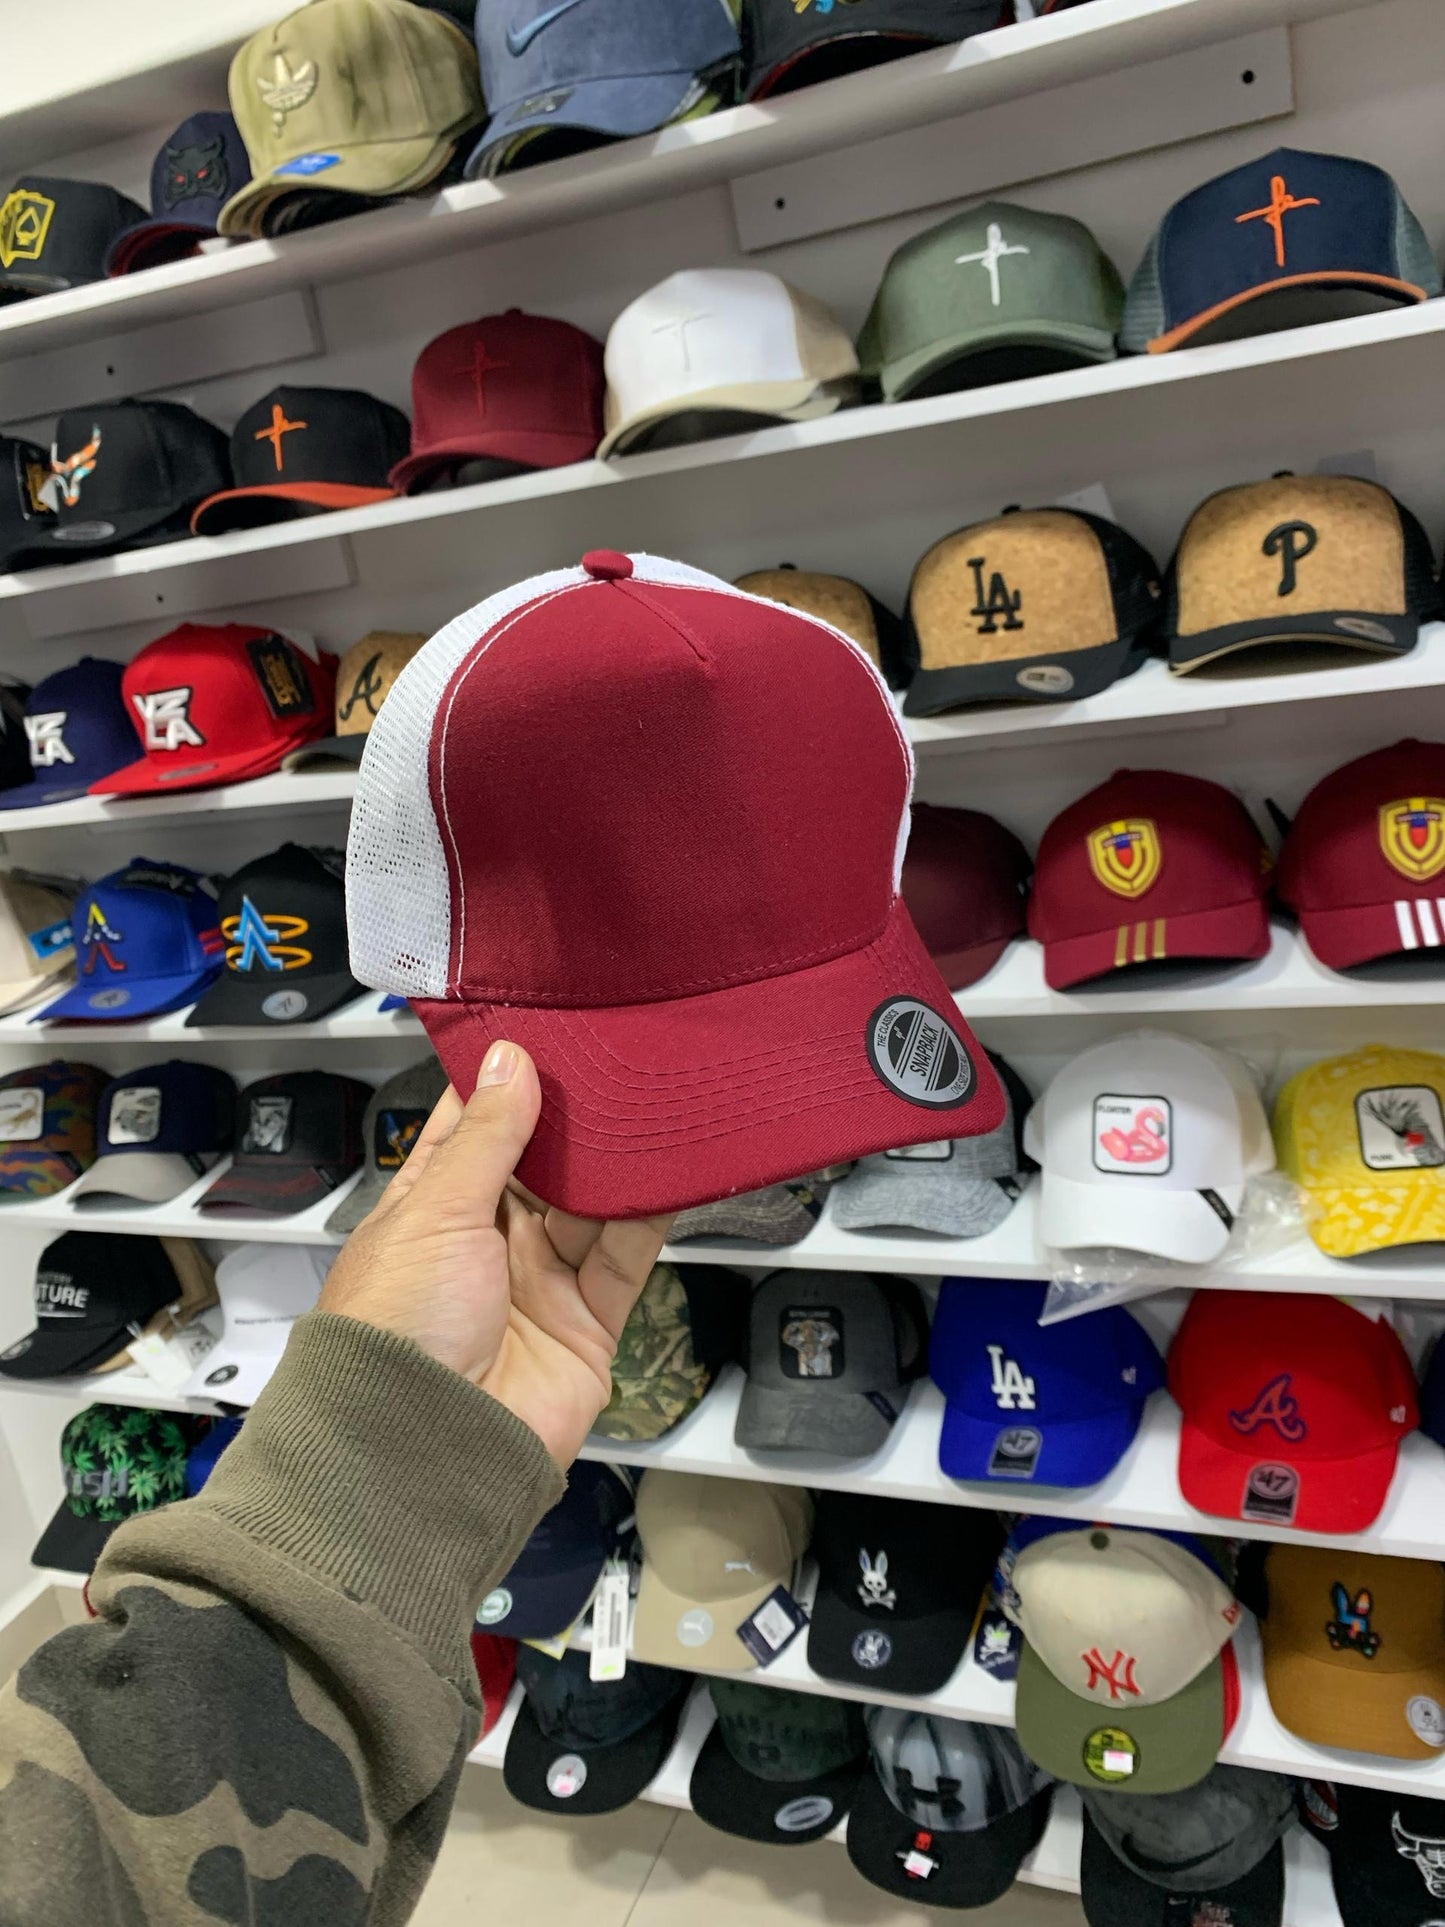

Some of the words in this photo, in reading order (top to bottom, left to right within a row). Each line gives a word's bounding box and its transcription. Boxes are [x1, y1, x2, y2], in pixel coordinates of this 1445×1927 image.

[1262, 520, 1318, 597] P
[967, 556, 1024, 634] LA
[339, 651, 387, 721] A
[877, 1033, 887, 1047] THE
[879, 1009, 900, 1034] CLASSICS
[910, 1022, 939, 1077] SNAPBACK
[986, 1344, 1036, 1410] LA
[1229, 1372, 1308, 1443] A
[1082, 1648, 1141, 1699] NY
